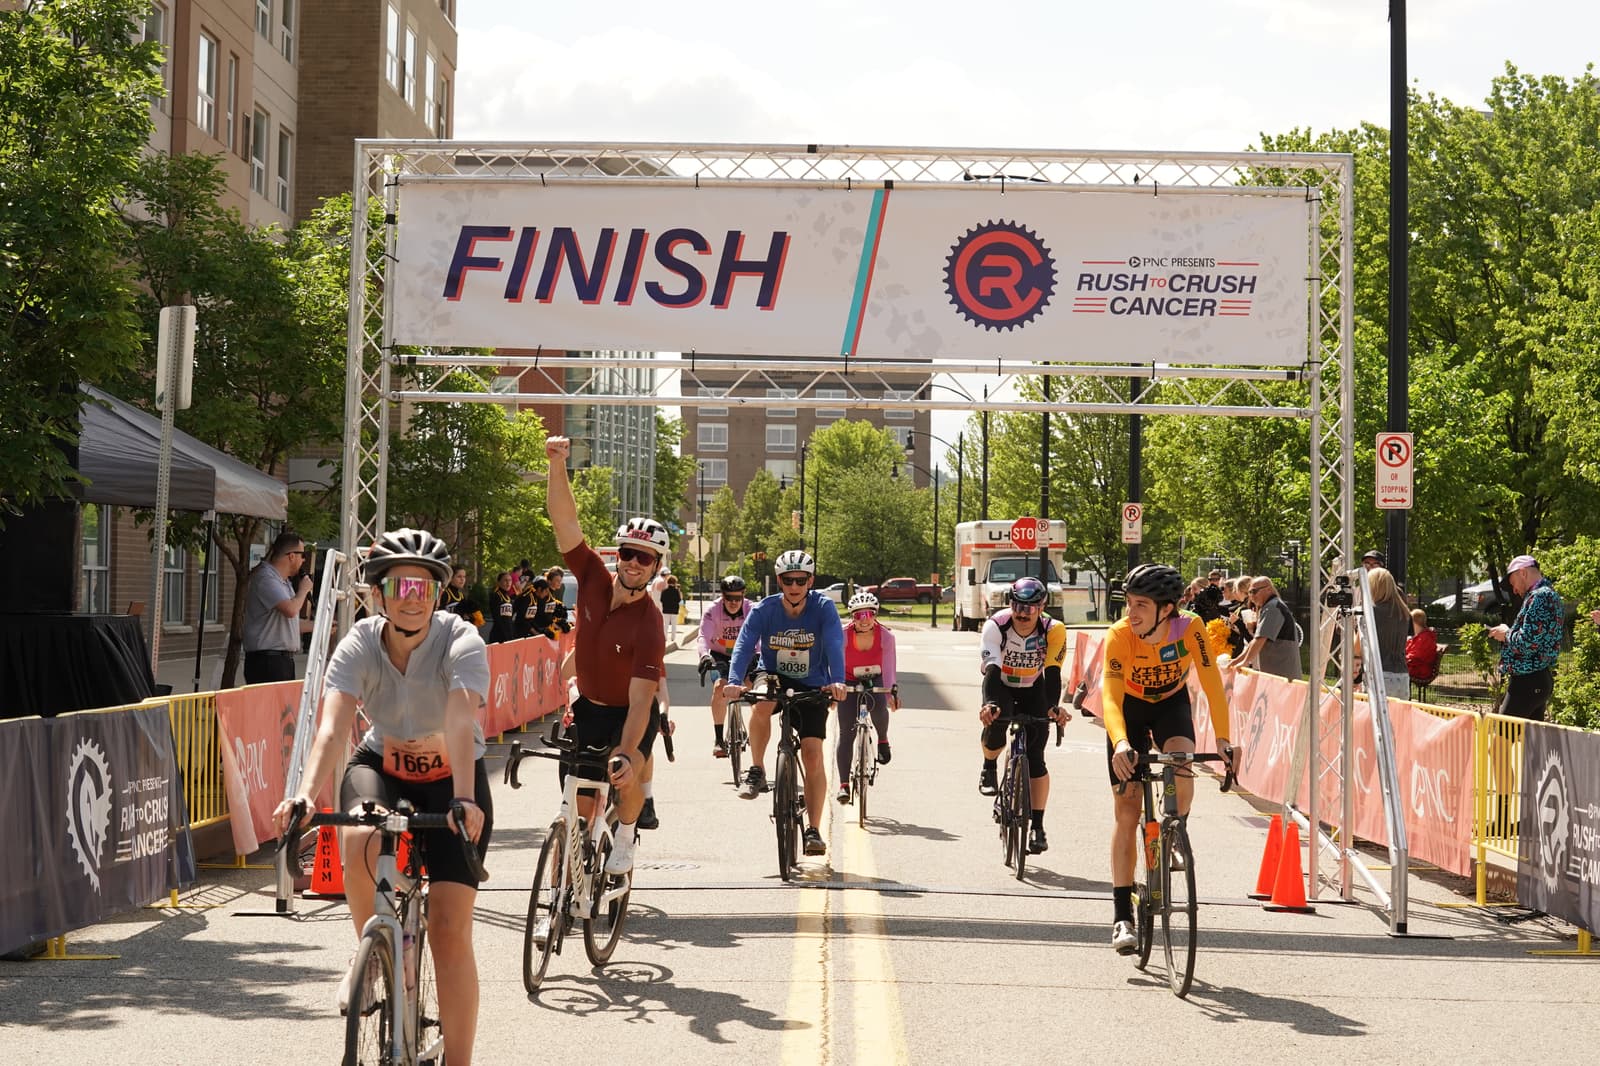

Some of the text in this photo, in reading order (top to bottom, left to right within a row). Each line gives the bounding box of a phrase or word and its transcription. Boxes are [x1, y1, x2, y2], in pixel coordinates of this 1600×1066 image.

[443, 225, 791, 311] FINISH
[1143, 257, 1215, 268] PNC PRESENTS
[1077, 272, 1257, 294] RUSH TO CRUSH
[1109, 297, 1217, 317] CANCER
[1381, 485, 1408, 494] STOPPING
[1012, 527, 1035, 540] STO
[780, 662, 807, 672] 3038
[391, 751, 444, 774] 1664
[136, 807, 144, 821] TO
[144, 795, 168, 825] CRUS
[132, 828, 164, 861] ANCER
[1573, 824, 1596, 852] RUSH
